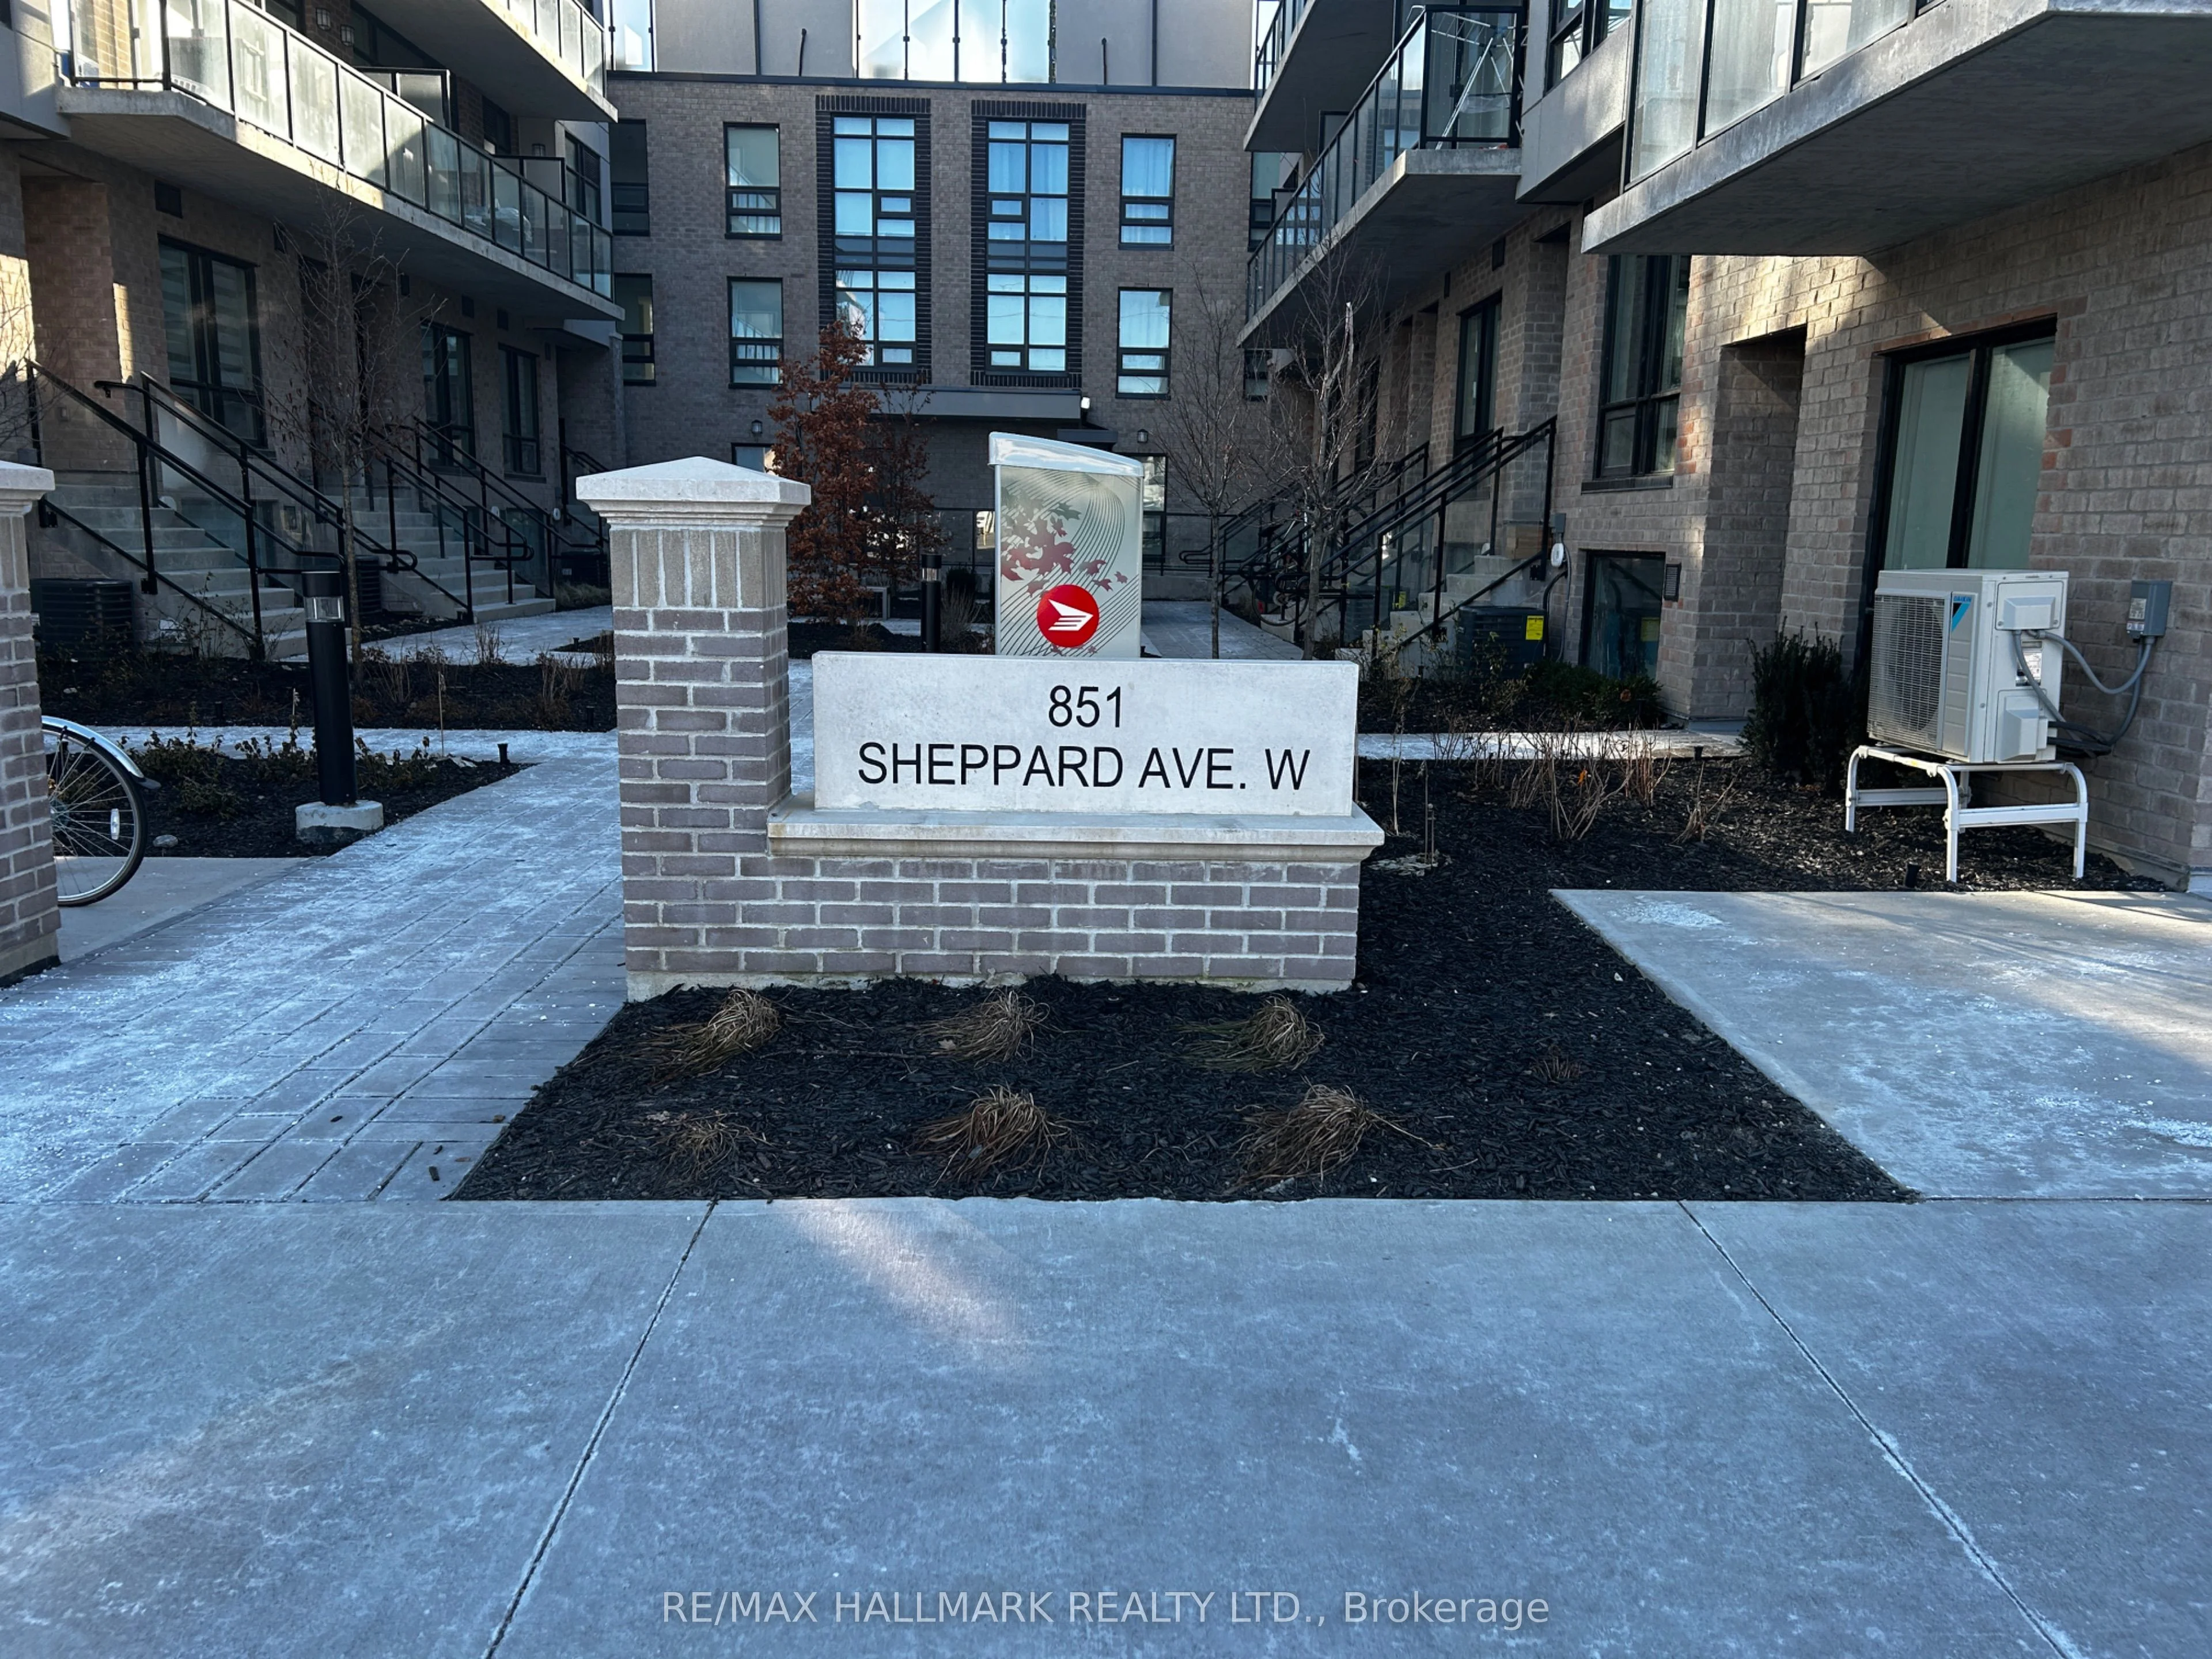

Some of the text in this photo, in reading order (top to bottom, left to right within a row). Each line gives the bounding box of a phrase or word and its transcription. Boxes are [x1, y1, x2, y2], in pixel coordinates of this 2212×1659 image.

[1048, 685, 1122, 728] 851
[858, 742, 1310, 790] SHEPPARD AVE. W
